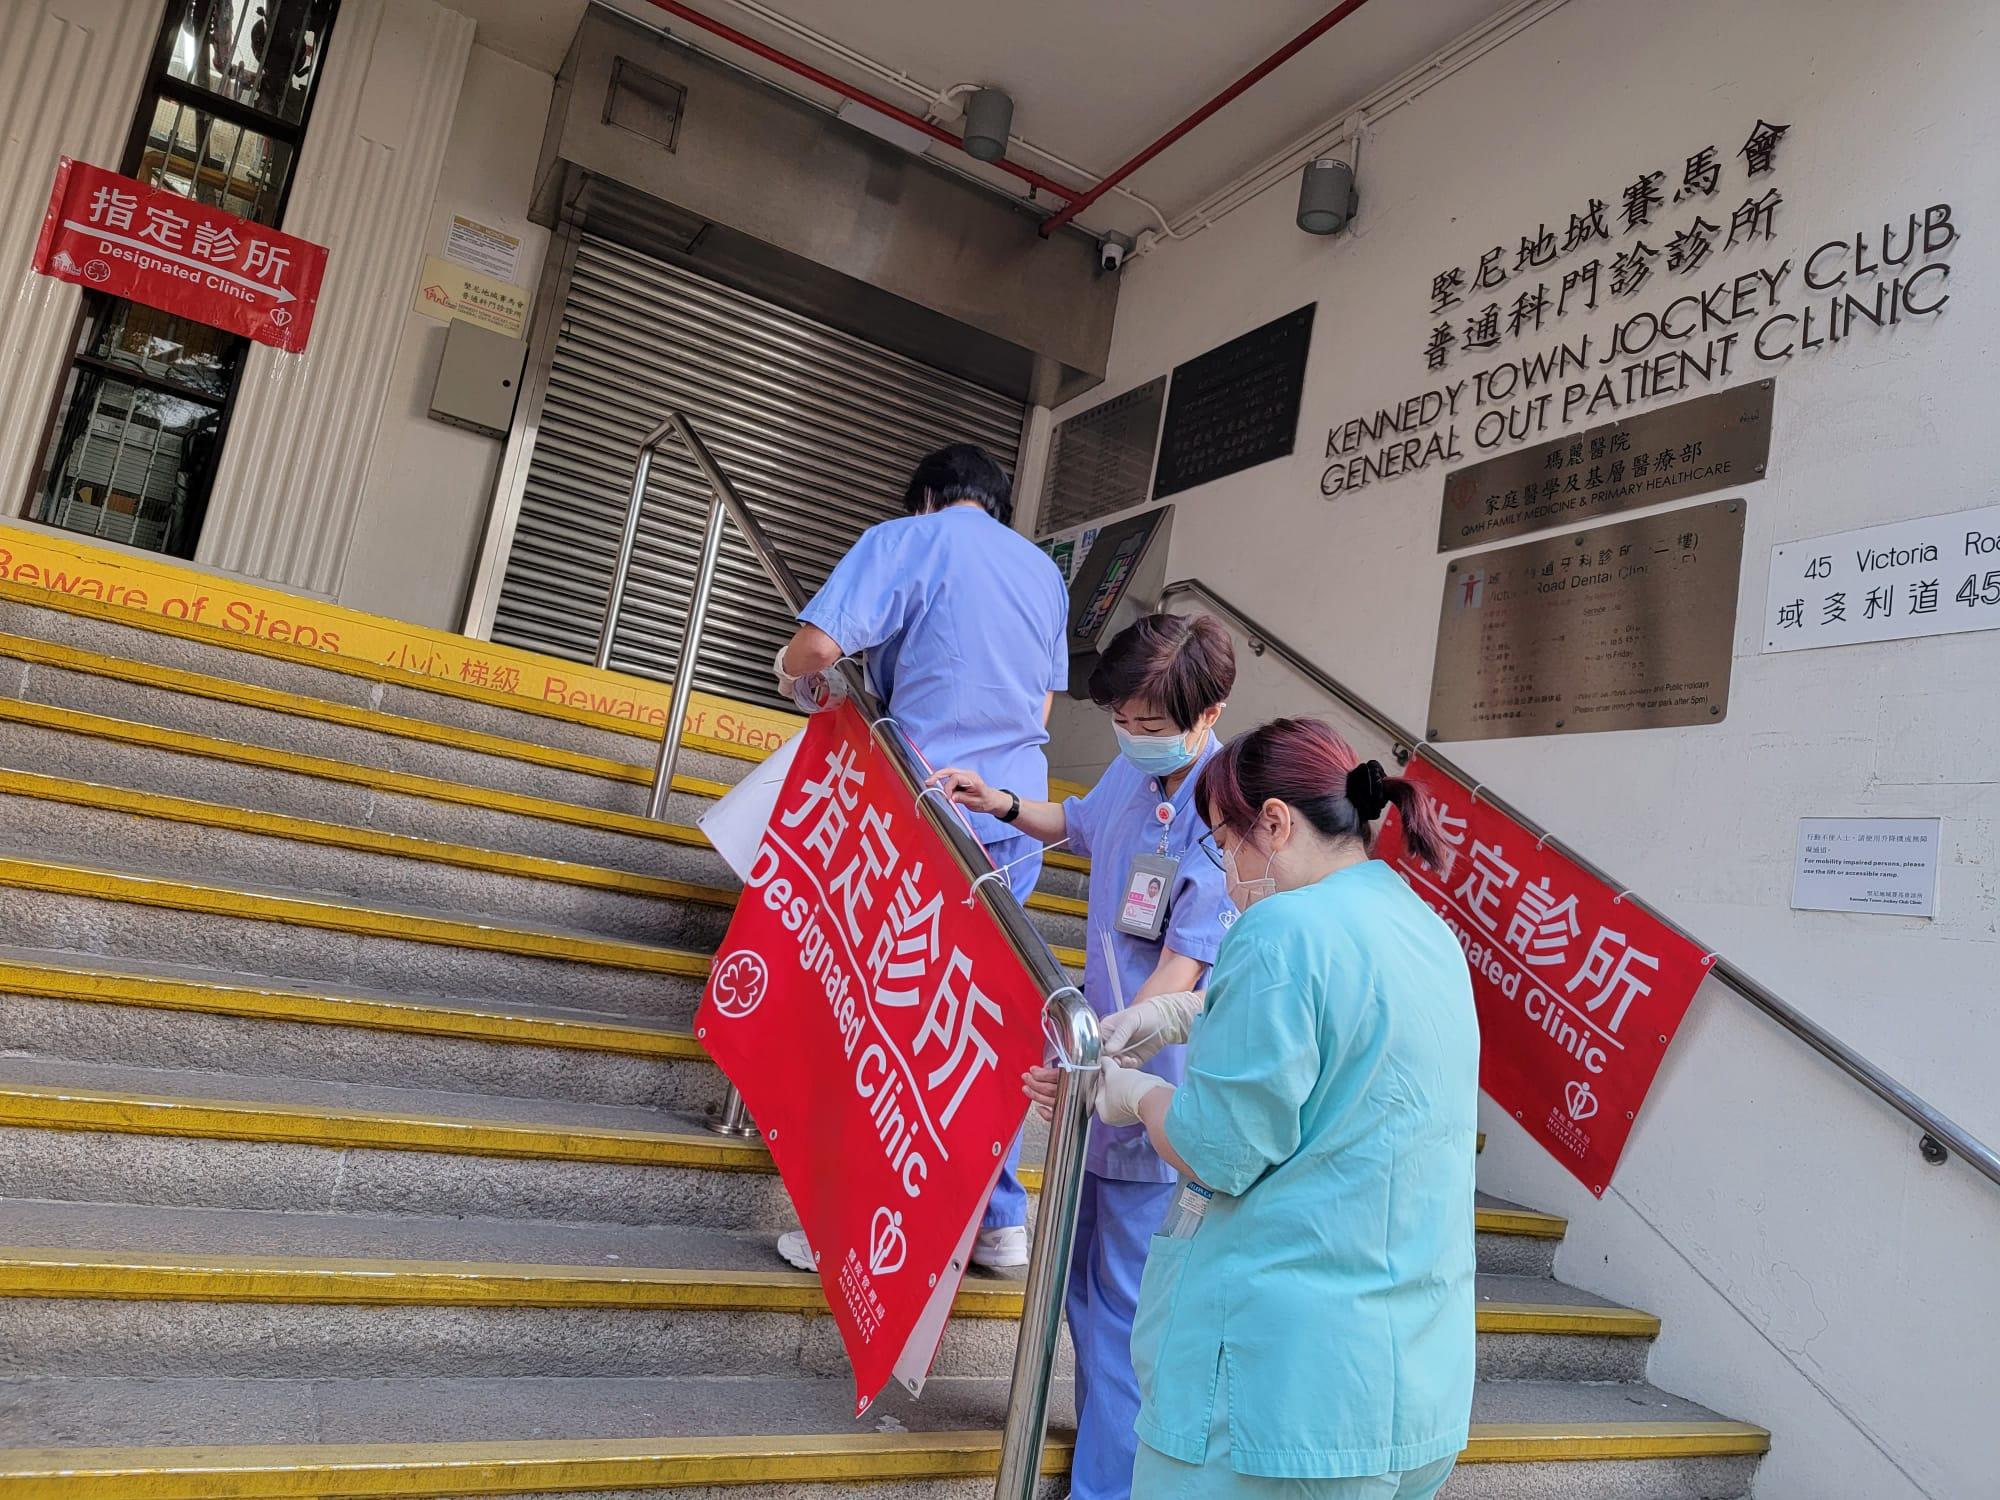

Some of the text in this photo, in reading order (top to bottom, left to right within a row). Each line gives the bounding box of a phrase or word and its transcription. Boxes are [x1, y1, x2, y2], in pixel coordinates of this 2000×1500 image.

[89, 186, 291, 285] 指定診所
[1430, 118, 1790, 316] 堅尼地城賽馬會
[99, 240, 256, 303] Designated Clinic
[1423, 187, 1784, 372] 普通科門診診所
[1326, 379, 1467, 458] KENNEDY
[1474, 332, 1590, 406] TOWN
[1600, 259, 1790, 365] JOCKEY
[1803, 204, 1958, 291] CLUB
[1320, 263, 1951, 497] GENERAL OUT PATIENT CLINIC
[1484, 440, 1703, 516] 家庭醫學及基層醫療部
[1544, 431, 1631, 471] 瑪麗醫院
[1461, 460, 1732, 537] QMH FAMILY MEDICINE & PRIMARY HEALTHCARE
[1804, 555, 1833, 579] 45
[1857, 543, 1938, 572] Victoria
[161, 596, 209, 623] of
[221, 601, 340, 653] Steps
[1777, 578, 1940, 629] 域多利道
[387, 644, 520, 695] 小心梯級
[543, 676, 665, 726] Beware
[714, 714, 788, 752] Step
[1816, 858, 1842, 866] mobility
[1843, 858, 1872, 867] impaired
[1872, 860, 1901, 868] persons,
[1902, 860, 1926, 868] please
[781, 740, 1004, 1130] 指定診所
[748, 842, 927, 1198] Designated Clinic
[1524, 988, 1607, 1074] Clinic
